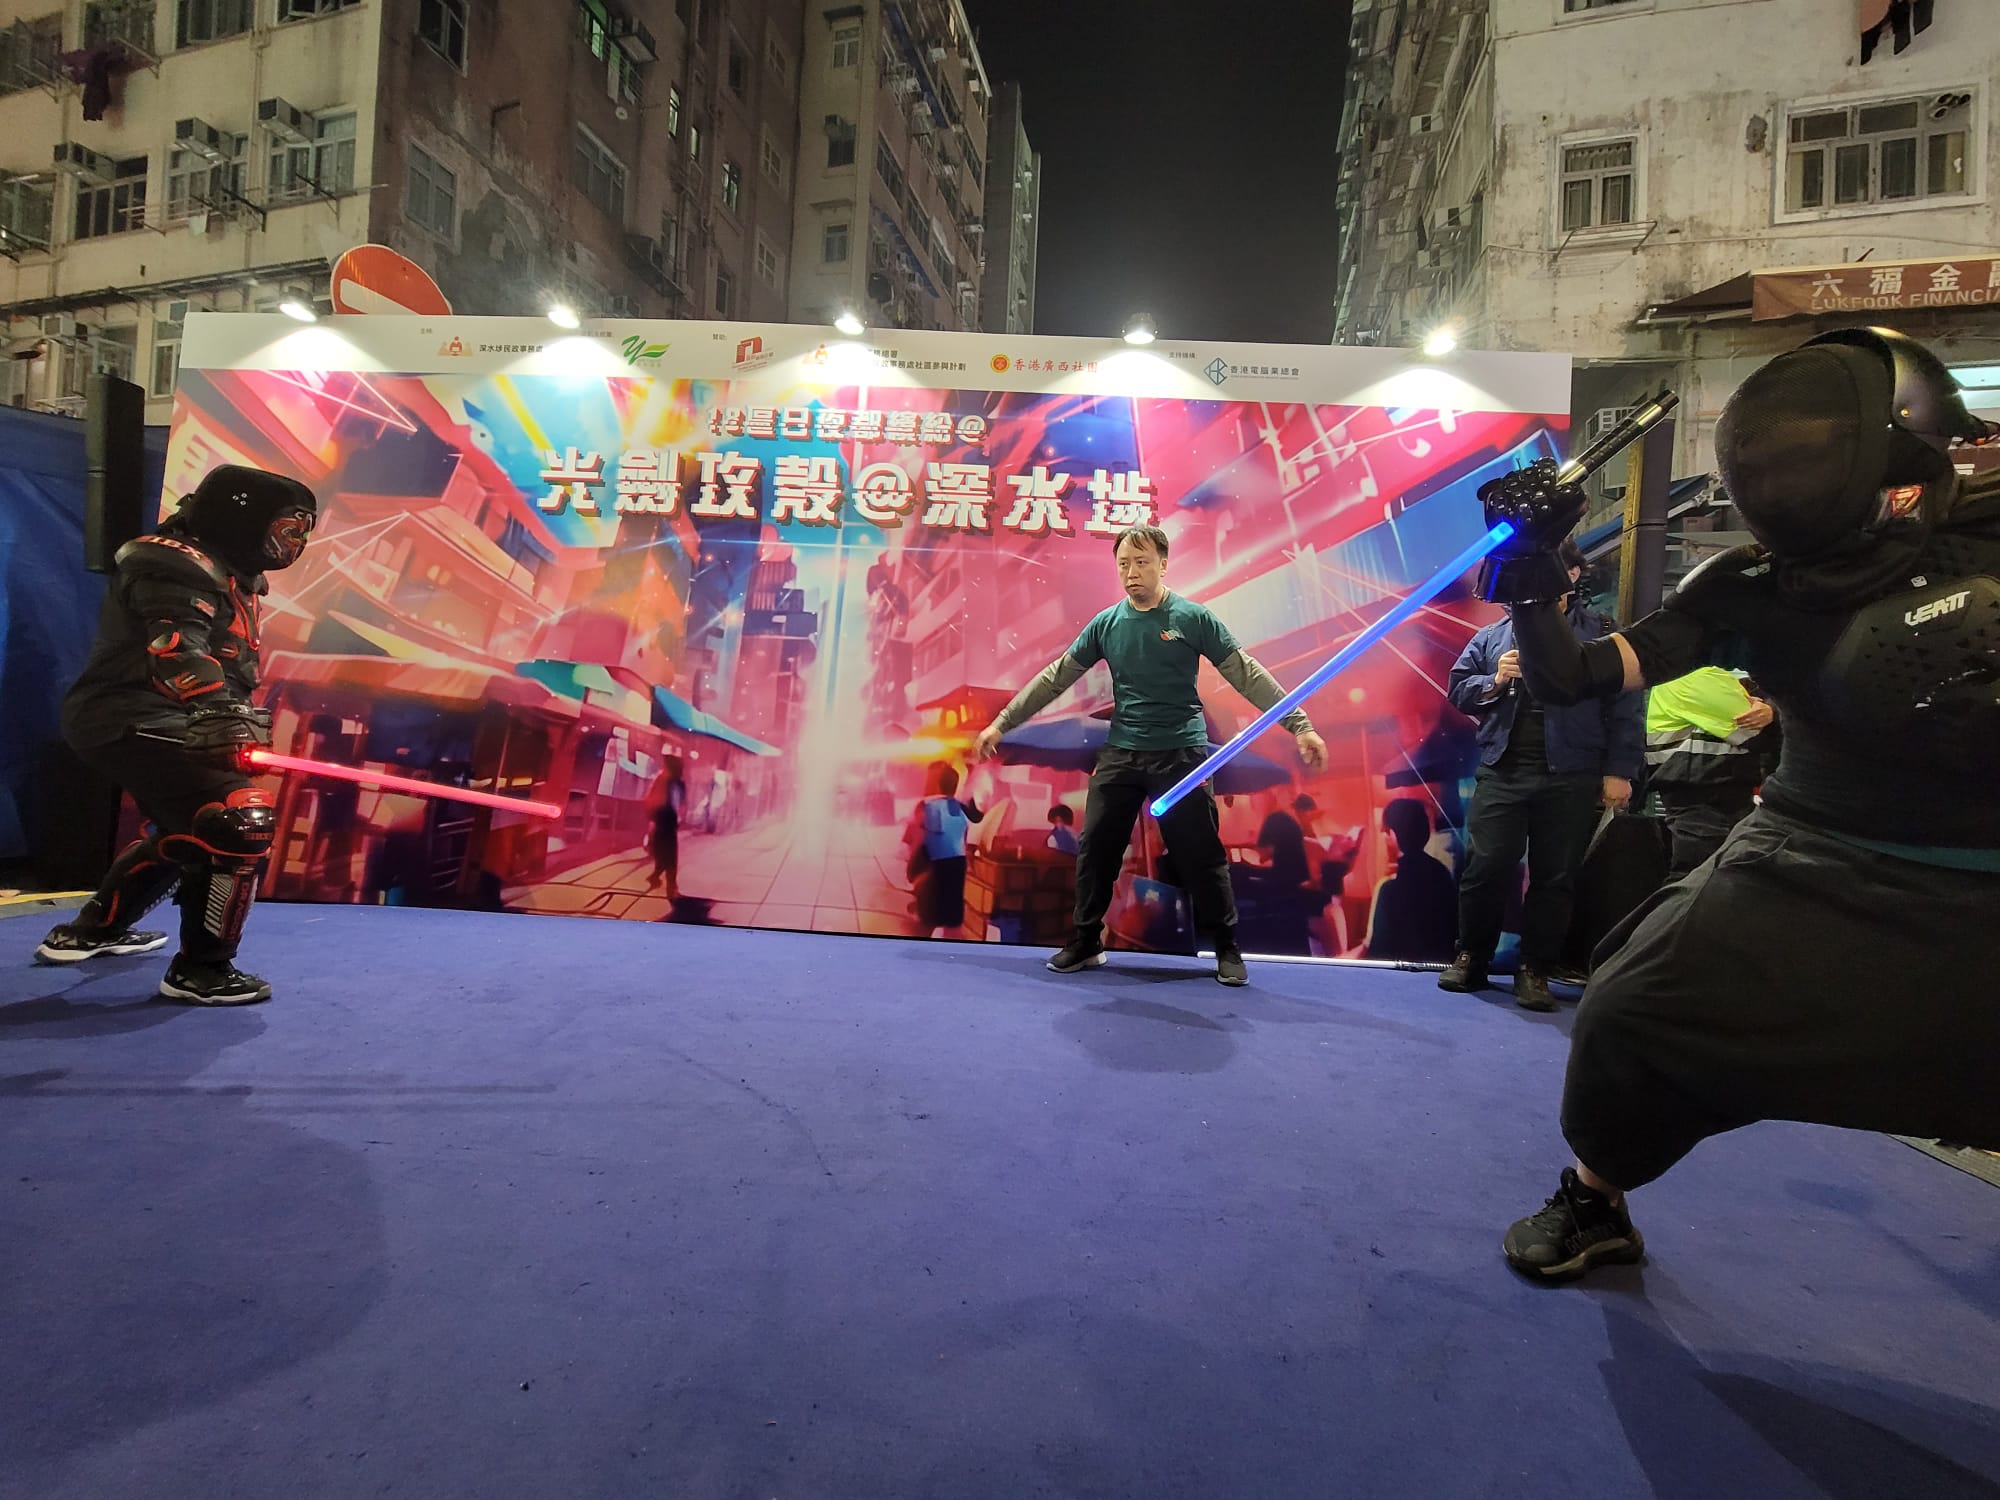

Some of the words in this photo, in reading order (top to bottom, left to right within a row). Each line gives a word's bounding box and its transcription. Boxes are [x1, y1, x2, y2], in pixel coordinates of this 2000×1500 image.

[874, 359, 967, 371] 政事務處社區參與計劃
[1904, 590, 1971, 626] LEATT
